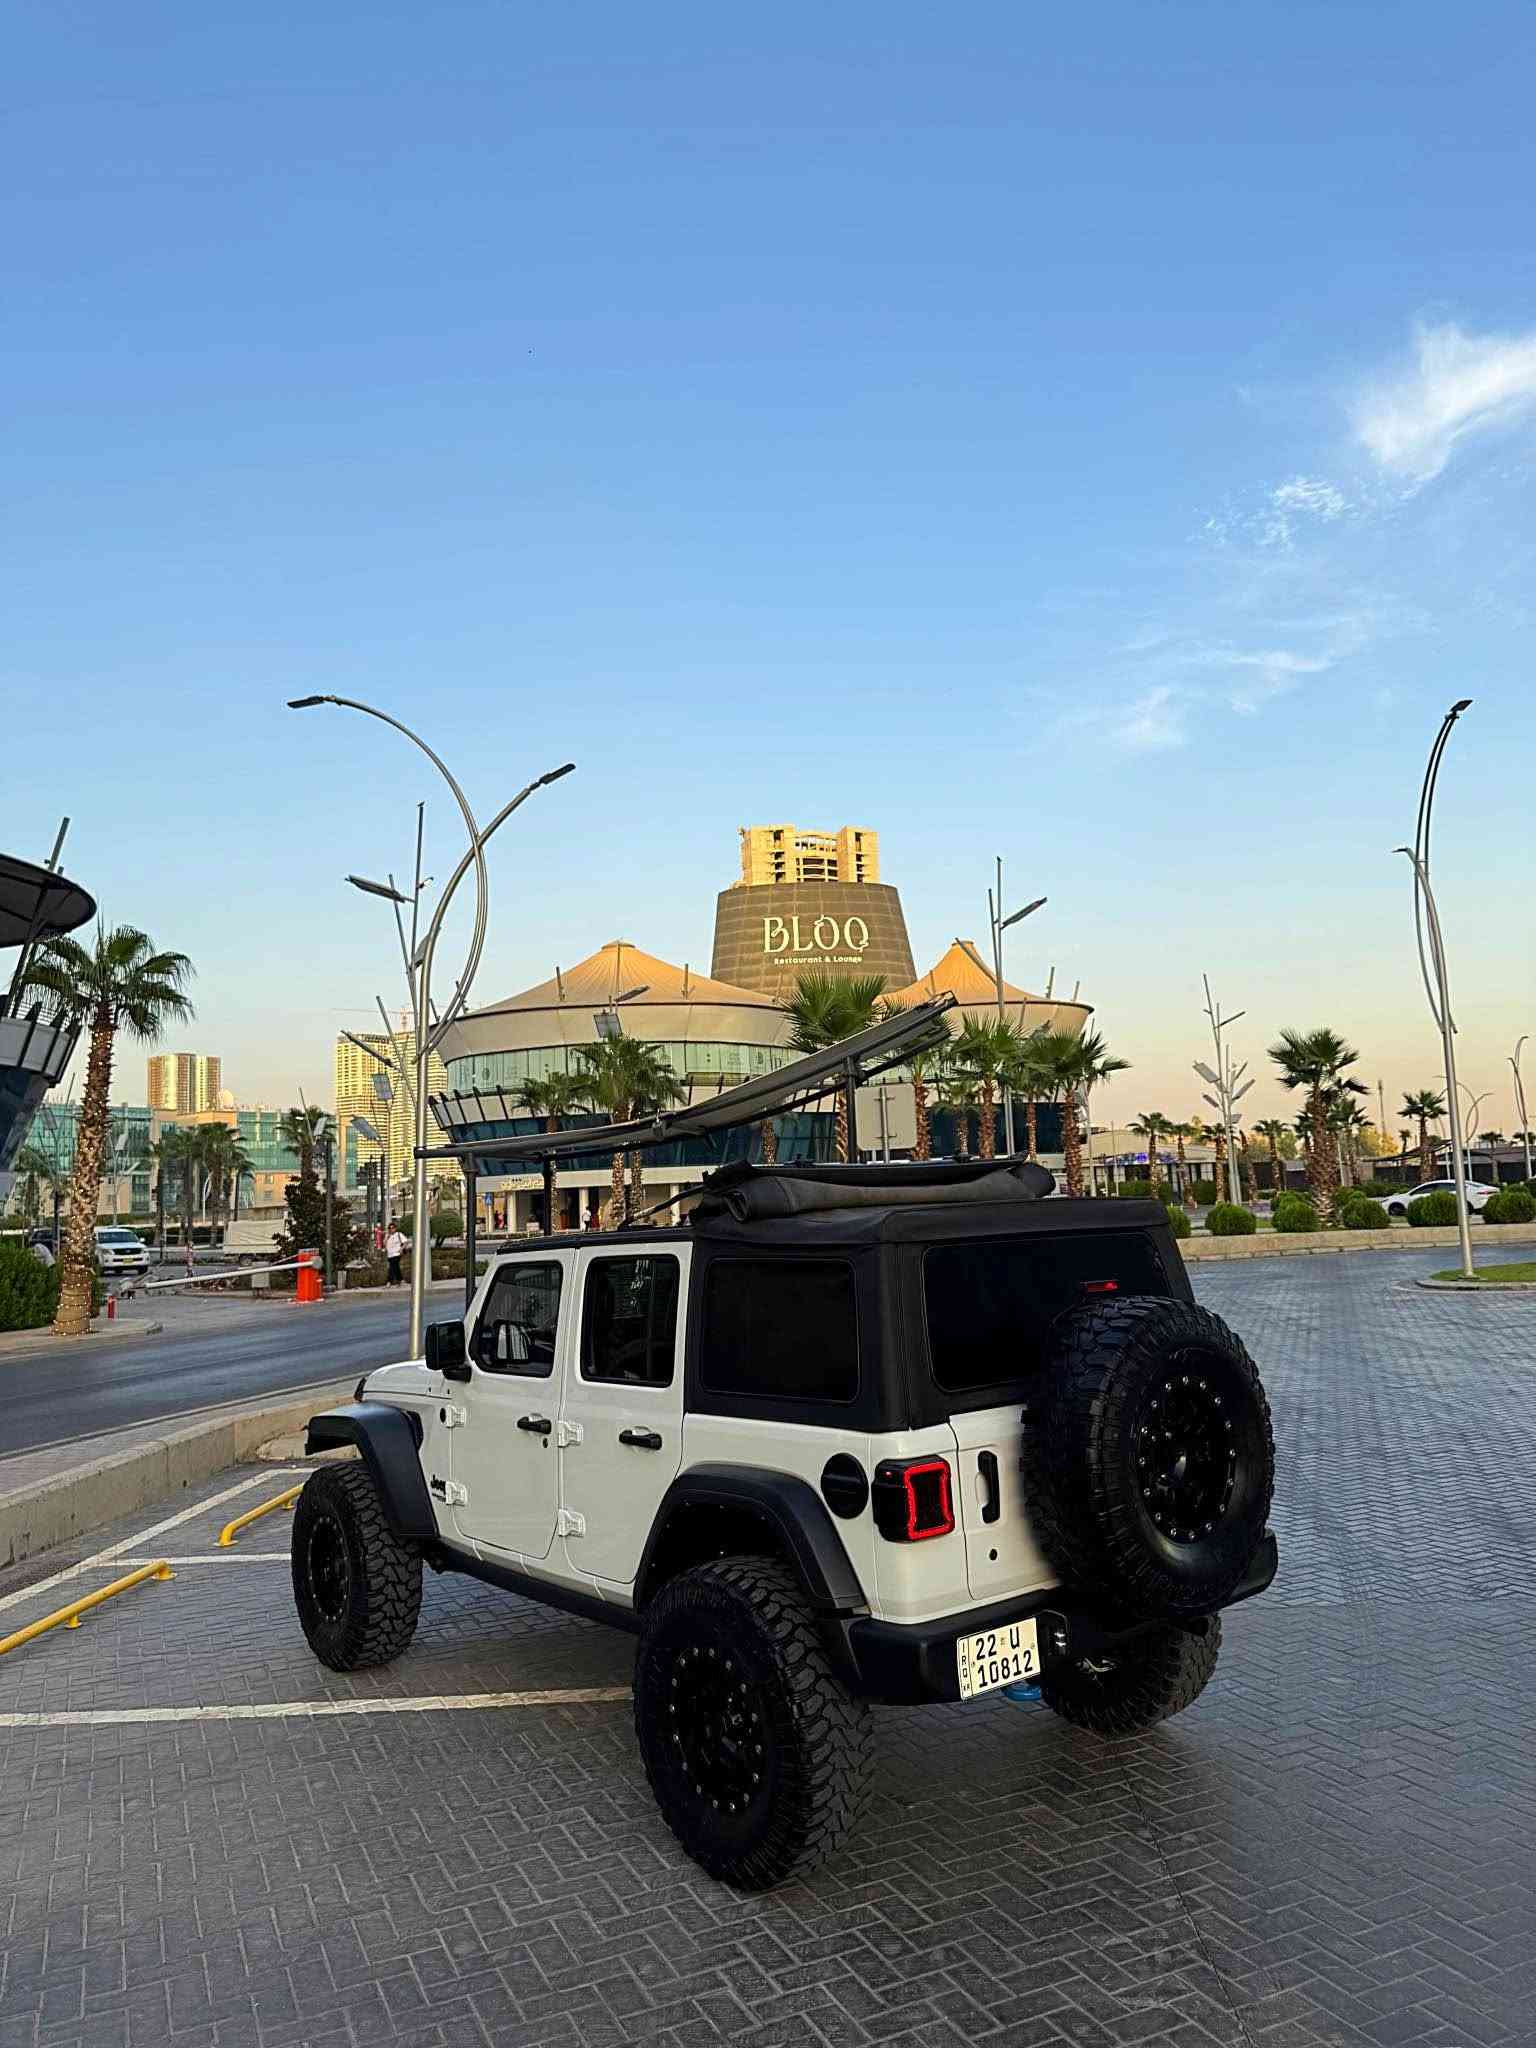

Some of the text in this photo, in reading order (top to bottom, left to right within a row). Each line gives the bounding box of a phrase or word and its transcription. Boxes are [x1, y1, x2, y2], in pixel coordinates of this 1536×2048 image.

[763, 914, 869, 953] BLOQ
[774, 956, 822, 965] Restaurant
[833, 955, 862, 964] Lounge
[975, 1626, 1020, 1661] 22 U
[977, 1649, 1033, 1688] 10812
